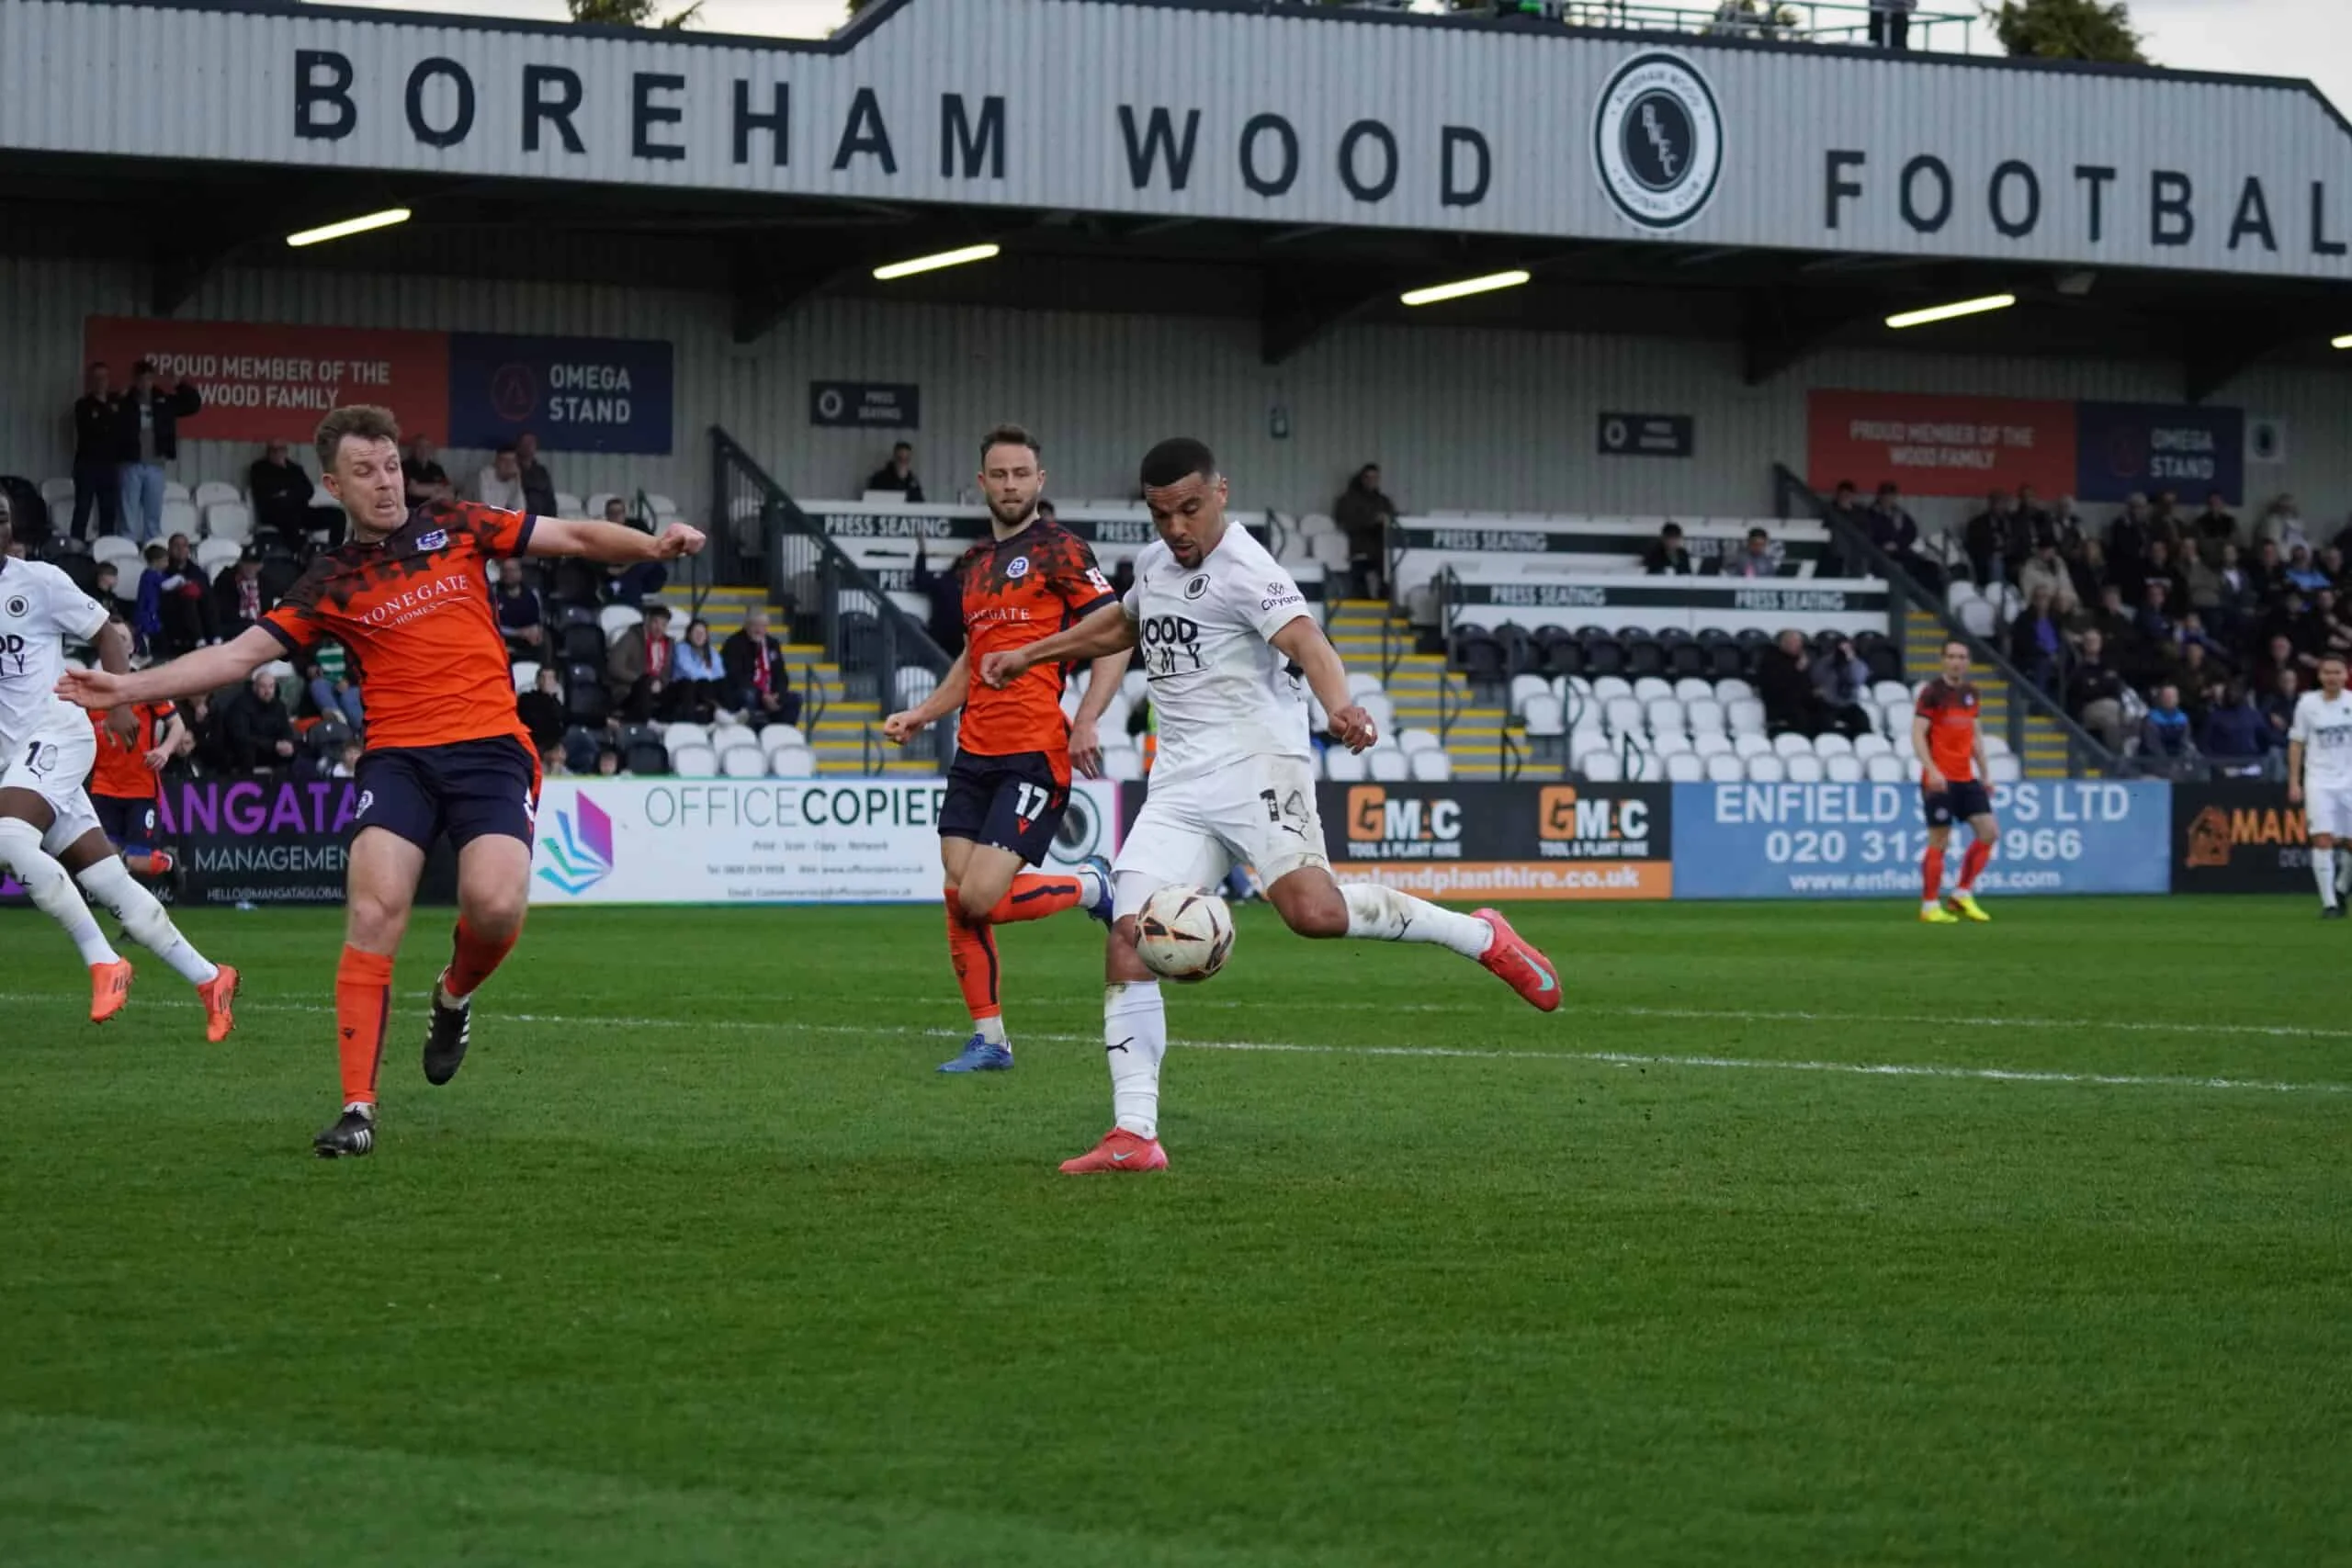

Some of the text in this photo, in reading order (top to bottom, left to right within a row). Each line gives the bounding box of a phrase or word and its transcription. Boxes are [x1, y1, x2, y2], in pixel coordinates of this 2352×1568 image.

[294, 49, 1005, 179] BOREHAM
[1116, 104, 1491, 208] WOOD
[222, 355, 312, 381] MEMBER
[318, 359, 345, 382] OF
[349, 361, 390, 385] THE
[549, 364, 632, 392] OMEGA
[197, 382, 340, 411] WOOD FAMILY
[548, 396, 631, 423] STAND
[2150, 457, 2214, 479] STAND
[824, 514, 951, 538] PRESS SEATING
[1096, 523, 1141, 541] PRESS
[1432, 531, 1547, 551] PRESS SEATING
[1490, 586, 1606, 606] PRESS SEATING
[1735, 590, 1845, 611] PRESS SEATING
[25, 739, 59, 772] 10
[1014, 782, 1049, 821] 17
[1714, 784, 1902, 823] ENFIELD
[2053, 784, 2131, 821] LTD
[144, 808, 155, 827] 6
[1347, 841, 1380, 857] TOOL
[1392, 841, 1430, 858] PLANT
[1540, 840, 1571, 856] TOOL
[1582, 840, 1620, 857] PLANT
[1765, 829, 1847, 863] 020
